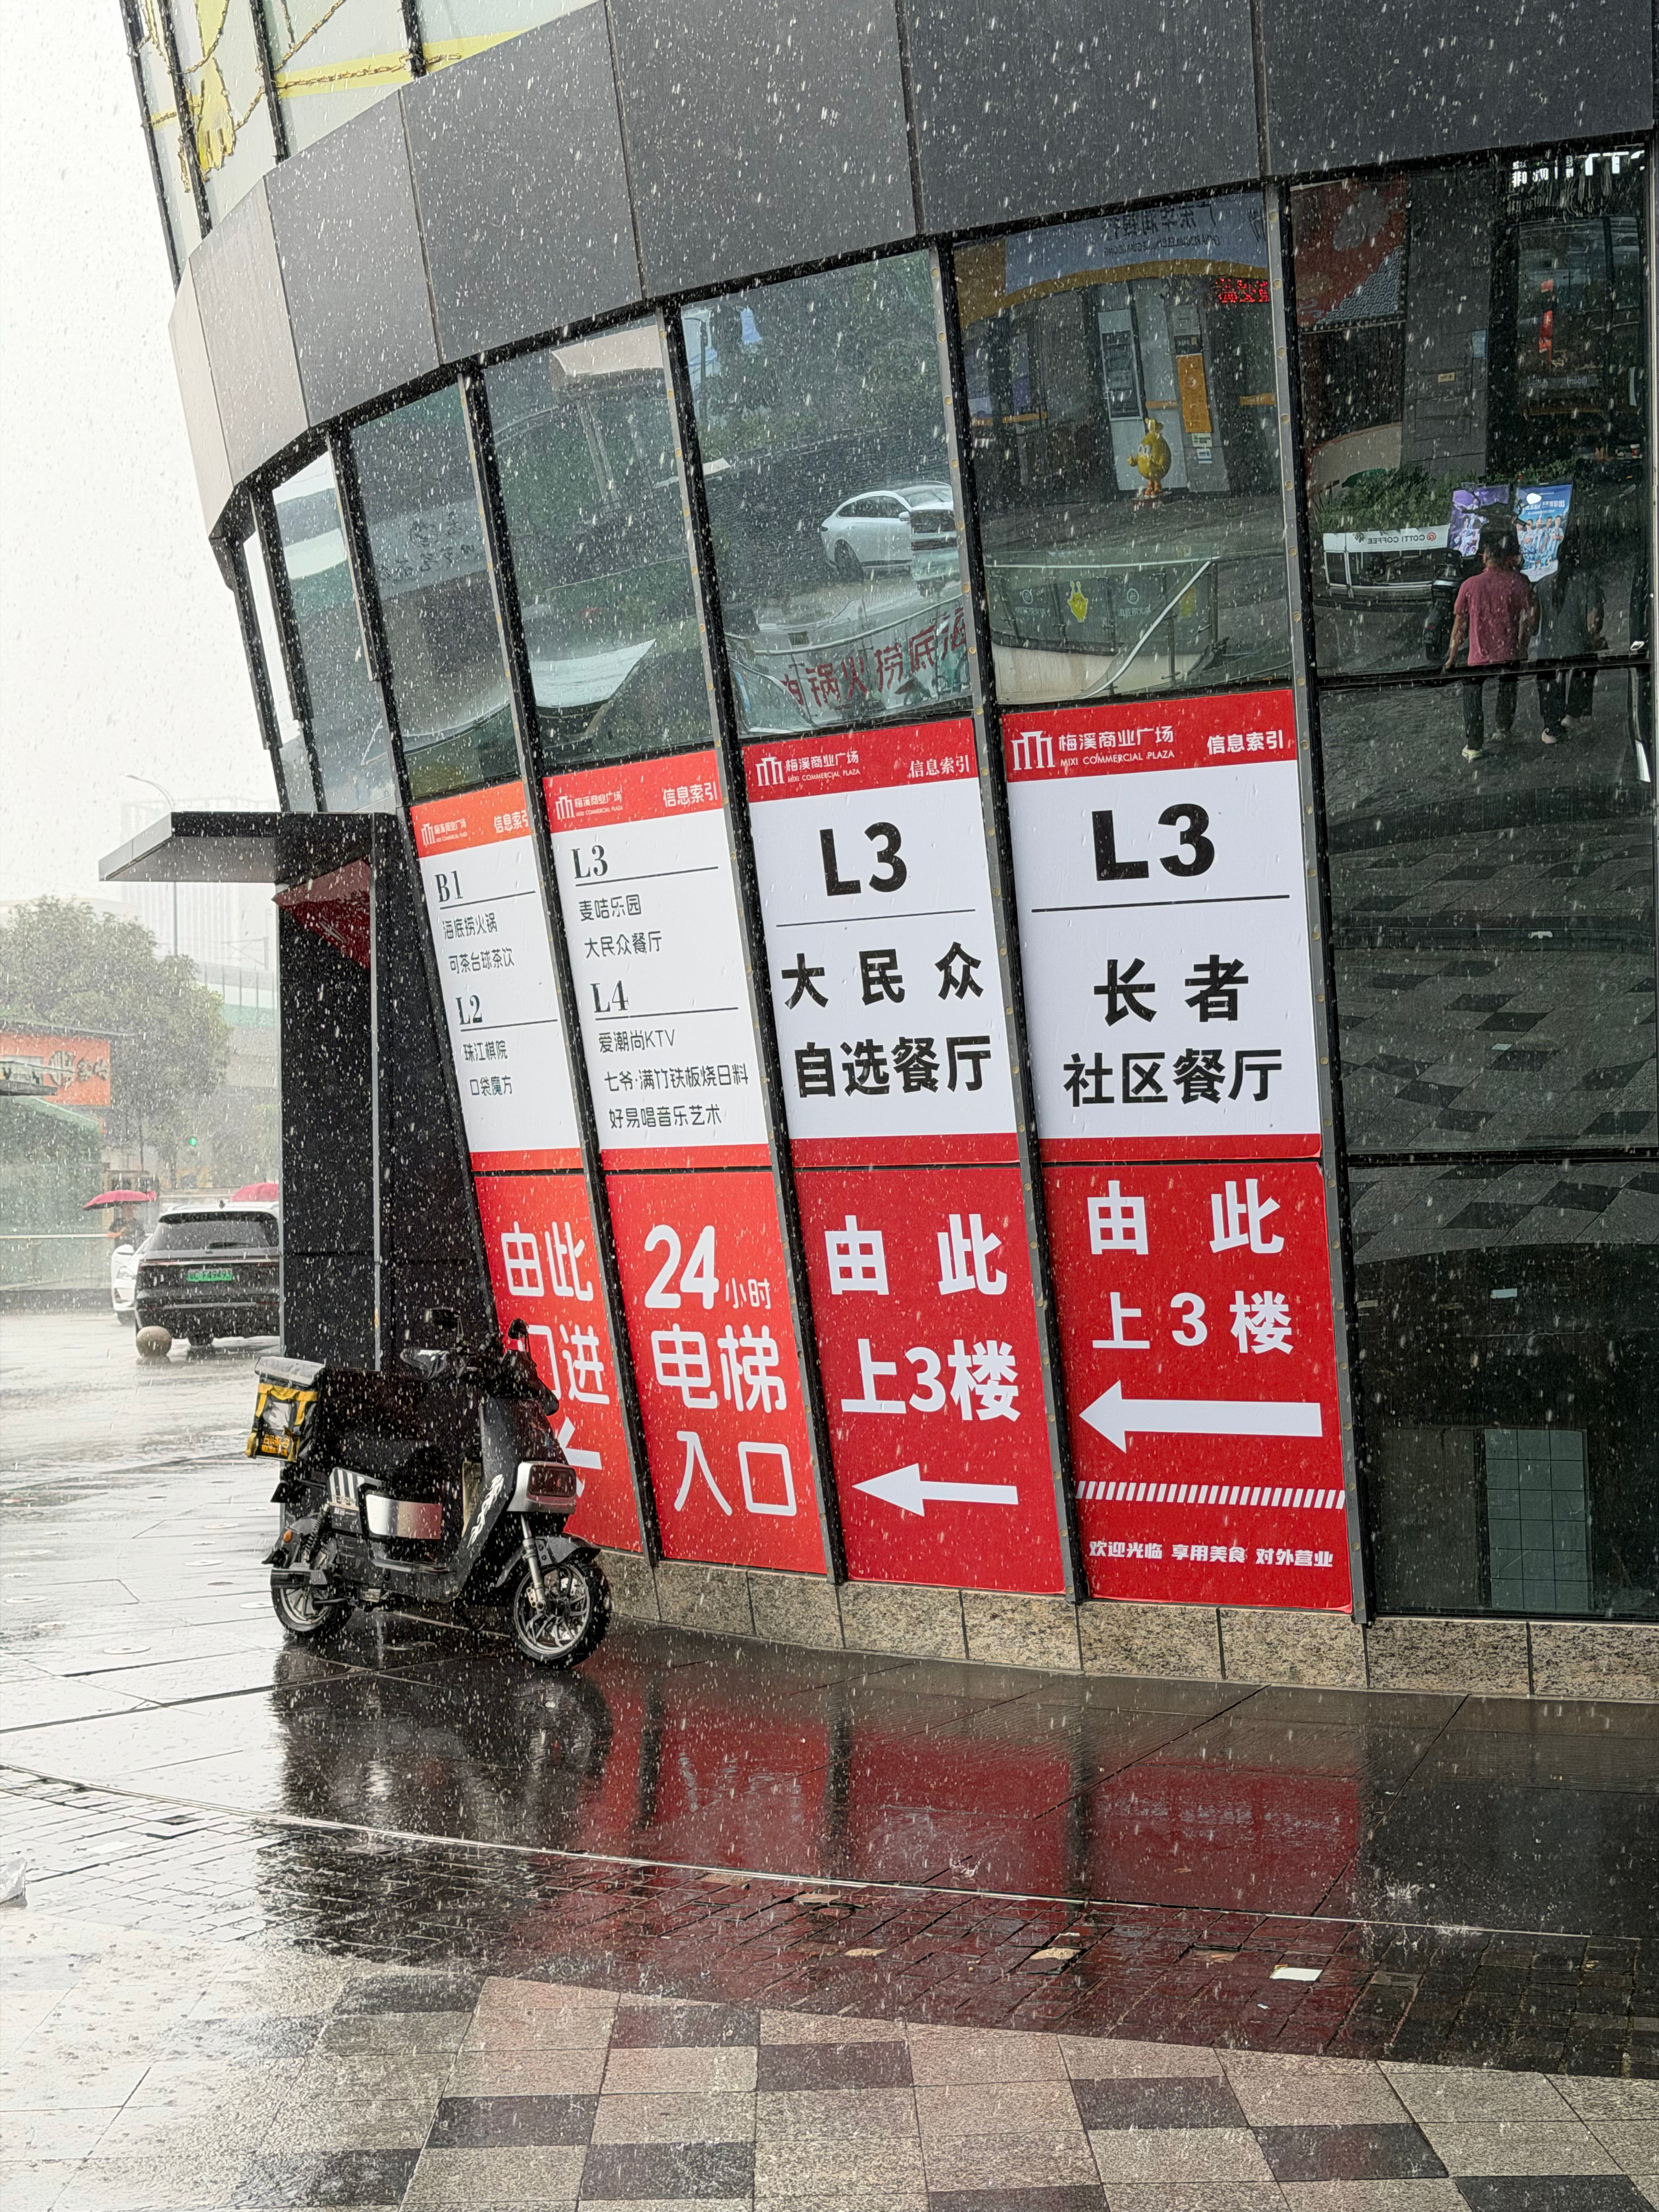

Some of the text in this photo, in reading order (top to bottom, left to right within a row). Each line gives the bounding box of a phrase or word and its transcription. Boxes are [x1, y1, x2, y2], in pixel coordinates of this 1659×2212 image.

[1058, 725, 1173, 752] 梅溪商业广场
[1207, 730, 1284, 755] 信息索引
[786, 751, 859, 771] 梅溪商业广场
[909, 754, 970, 778] 信息索引
[1060, 750, 1175, 766] MIXI COMMERCIAL PLAZA
[787, 769, 860, 783] MIXI COMMERCIAL PLAZA
[663, 781, 718, 808] 信息索引
[494, 810, 528, 833] 信息索引
[1092, 804, 1215, 881] L3
[573, 845, 607, 878] L3
[820, 822, 907, 896] L3
[435, 871, 462, 902] B1
[579, 894, 641, 921] 麦咭乐园
[442, 912, 498, 940] 海底捞火锅
[585, 931, 661, 958] 大民众餐厅
[448, 946, 515, 974] 可茶台球茶饮
[781, 942, 983, 1009] 大民众
[591, 981, 628, 1012] L4
[1094, 955, 1248, 1026] 长者
[456, 995, 482, 1025] L2
[462, 1040, 508, 1062] 珠江棋院
[599, 1030, 674, 1052] 爱潮尚KTV
[794, 1036, 991, 1098] 自选餐厅
[1063, 1048, 1282, 1107] 社区餐厅
[470, 1075, 512, 1096] 口袋魔方
[609, 1104, 721, 1128] 好易唱音乐艺术
[1088, 1179, 1284, 1254] 由此
[501, 1222, 593, 1301] 由此
[825, 1214, 1007, 1295] 由此
[1093, 1291, 1293, 1354] 上3楼
[651, 1323, 786, 1413] 电梯
[842, 1339, 1020, 1421] 上3楼
[675, 1431, 797, 1516] 入口
[1090, 1541, 1333, 1567] 欢迎光临 享用美食 对外营业
